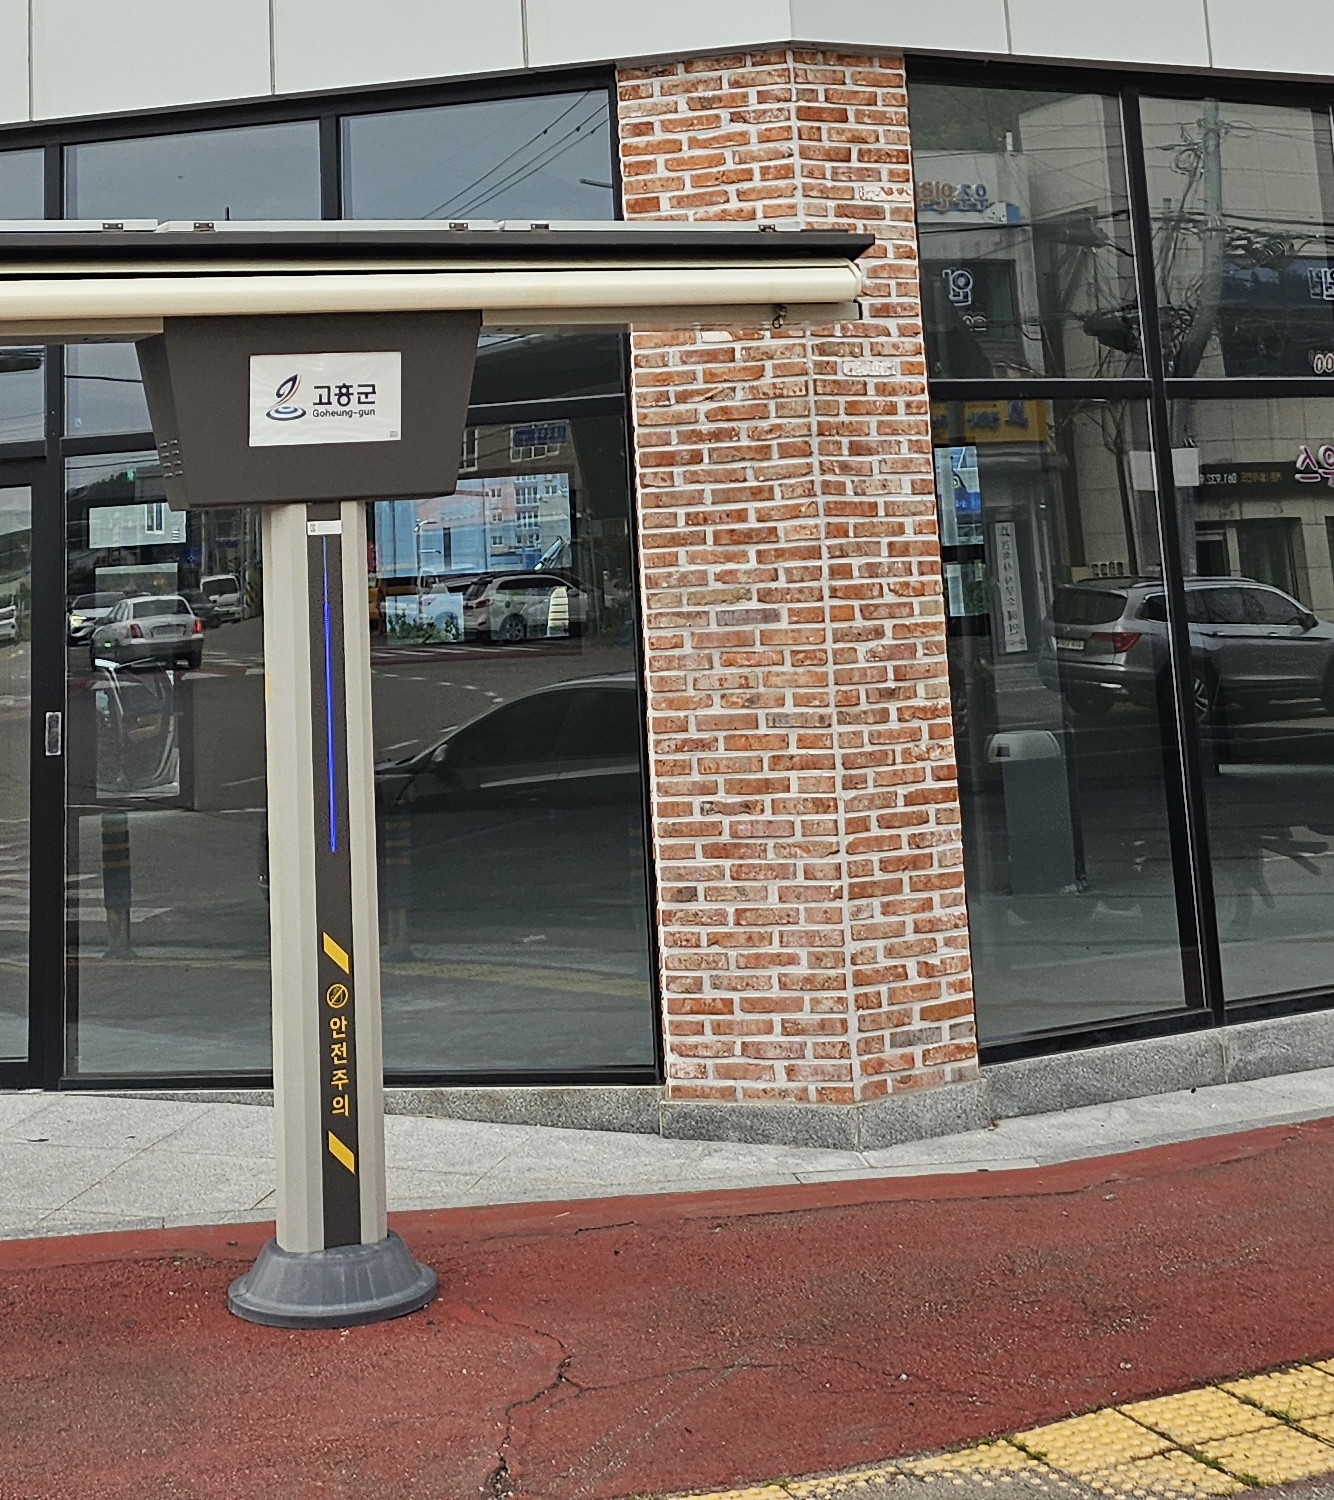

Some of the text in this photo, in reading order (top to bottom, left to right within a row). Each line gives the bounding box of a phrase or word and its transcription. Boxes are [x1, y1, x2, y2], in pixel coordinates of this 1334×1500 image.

[313, 383, 377, 407] 고흥군
[312, 408, 376, 419] Goheung-gun
[328, 1015, 350, 1118] 안전주의
